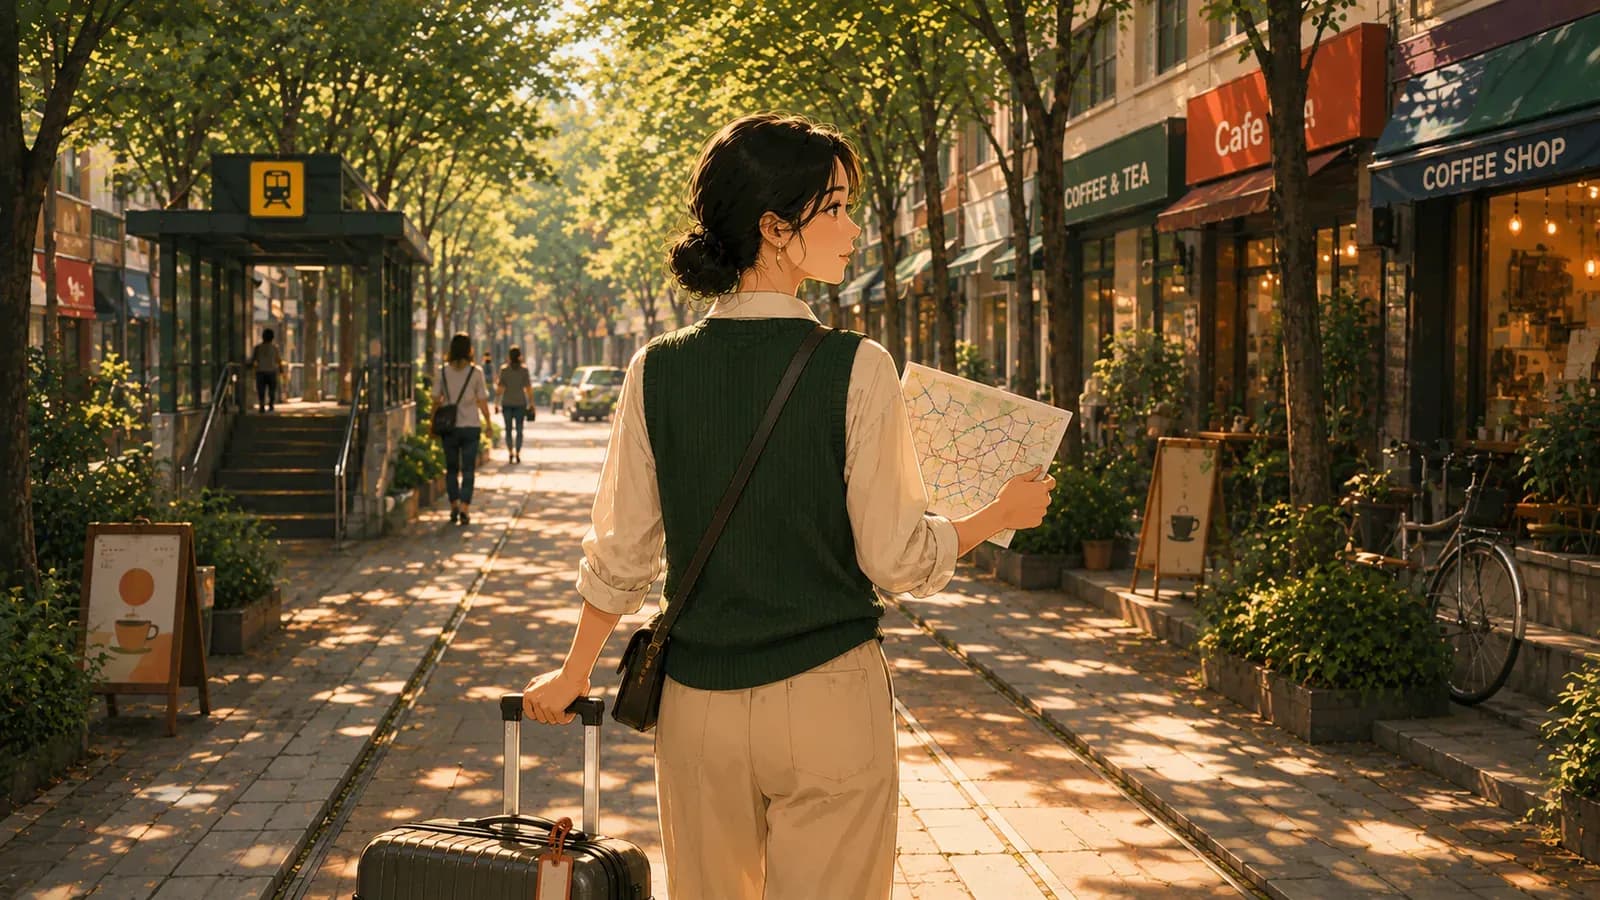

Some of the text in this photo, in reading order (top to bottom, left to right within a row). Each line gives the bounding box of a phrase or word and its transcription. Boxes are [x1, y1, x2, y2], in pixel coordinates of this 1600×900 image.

[1215, 111, 1264, 156] Cafe
[1064, 160, 1150, 210] COFFEE & TEA
[1423, 136, 1567, 190] COFFEE SHOP
